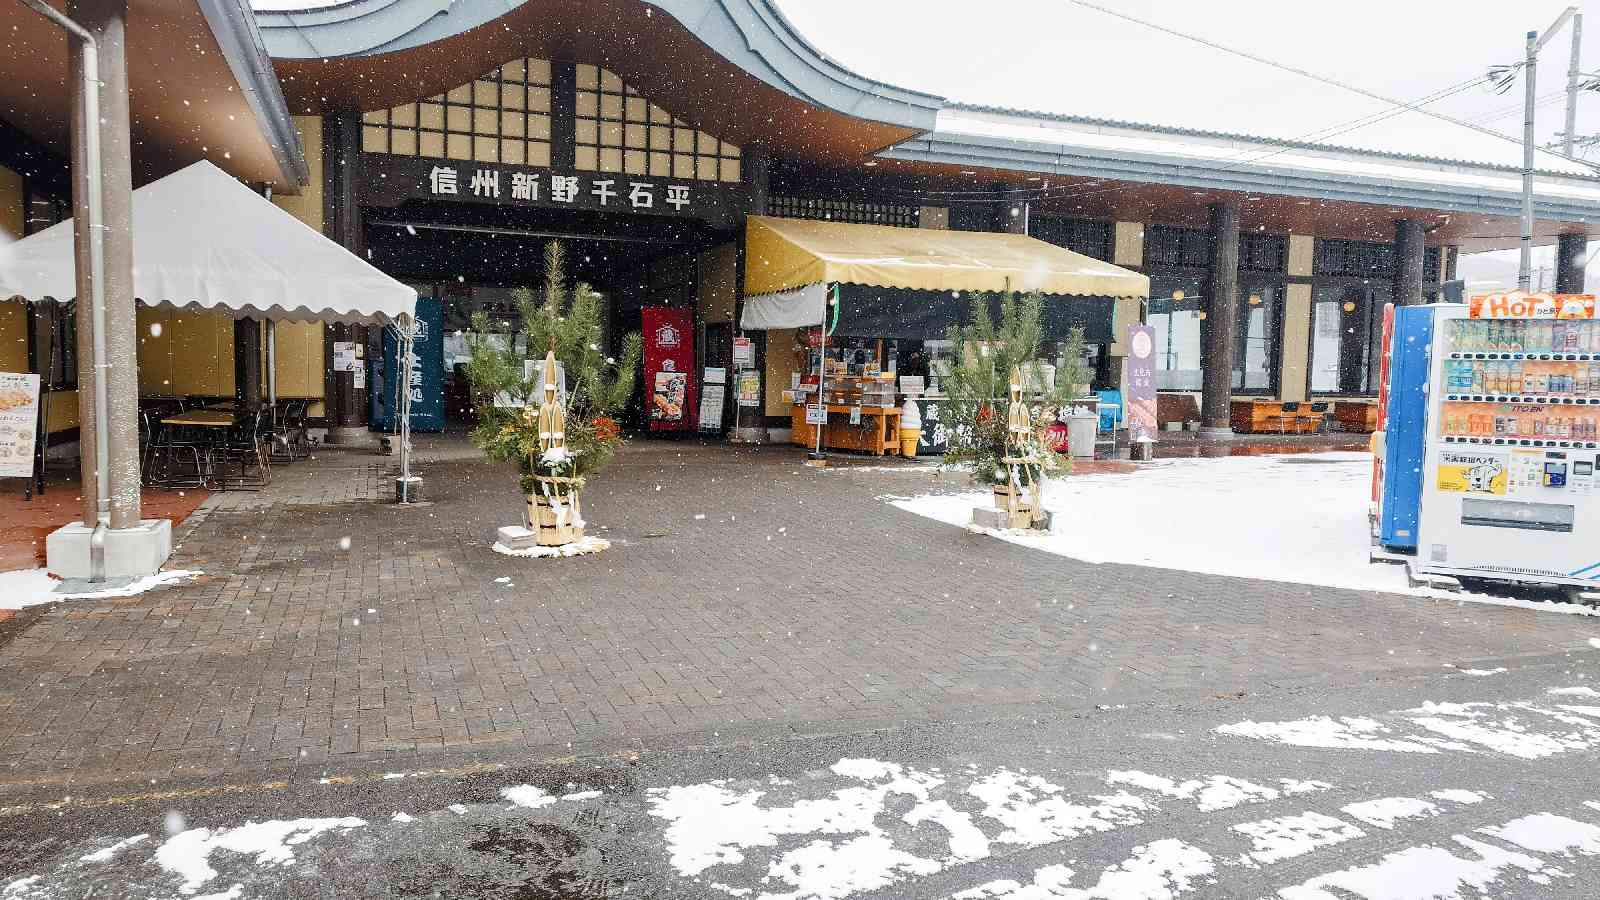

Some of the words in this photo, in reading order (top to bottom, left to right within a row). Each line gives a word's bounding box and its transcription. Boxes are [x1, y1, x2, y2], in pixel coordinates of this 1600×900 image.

[430, 165, 691, 211] 信州新野千石平
